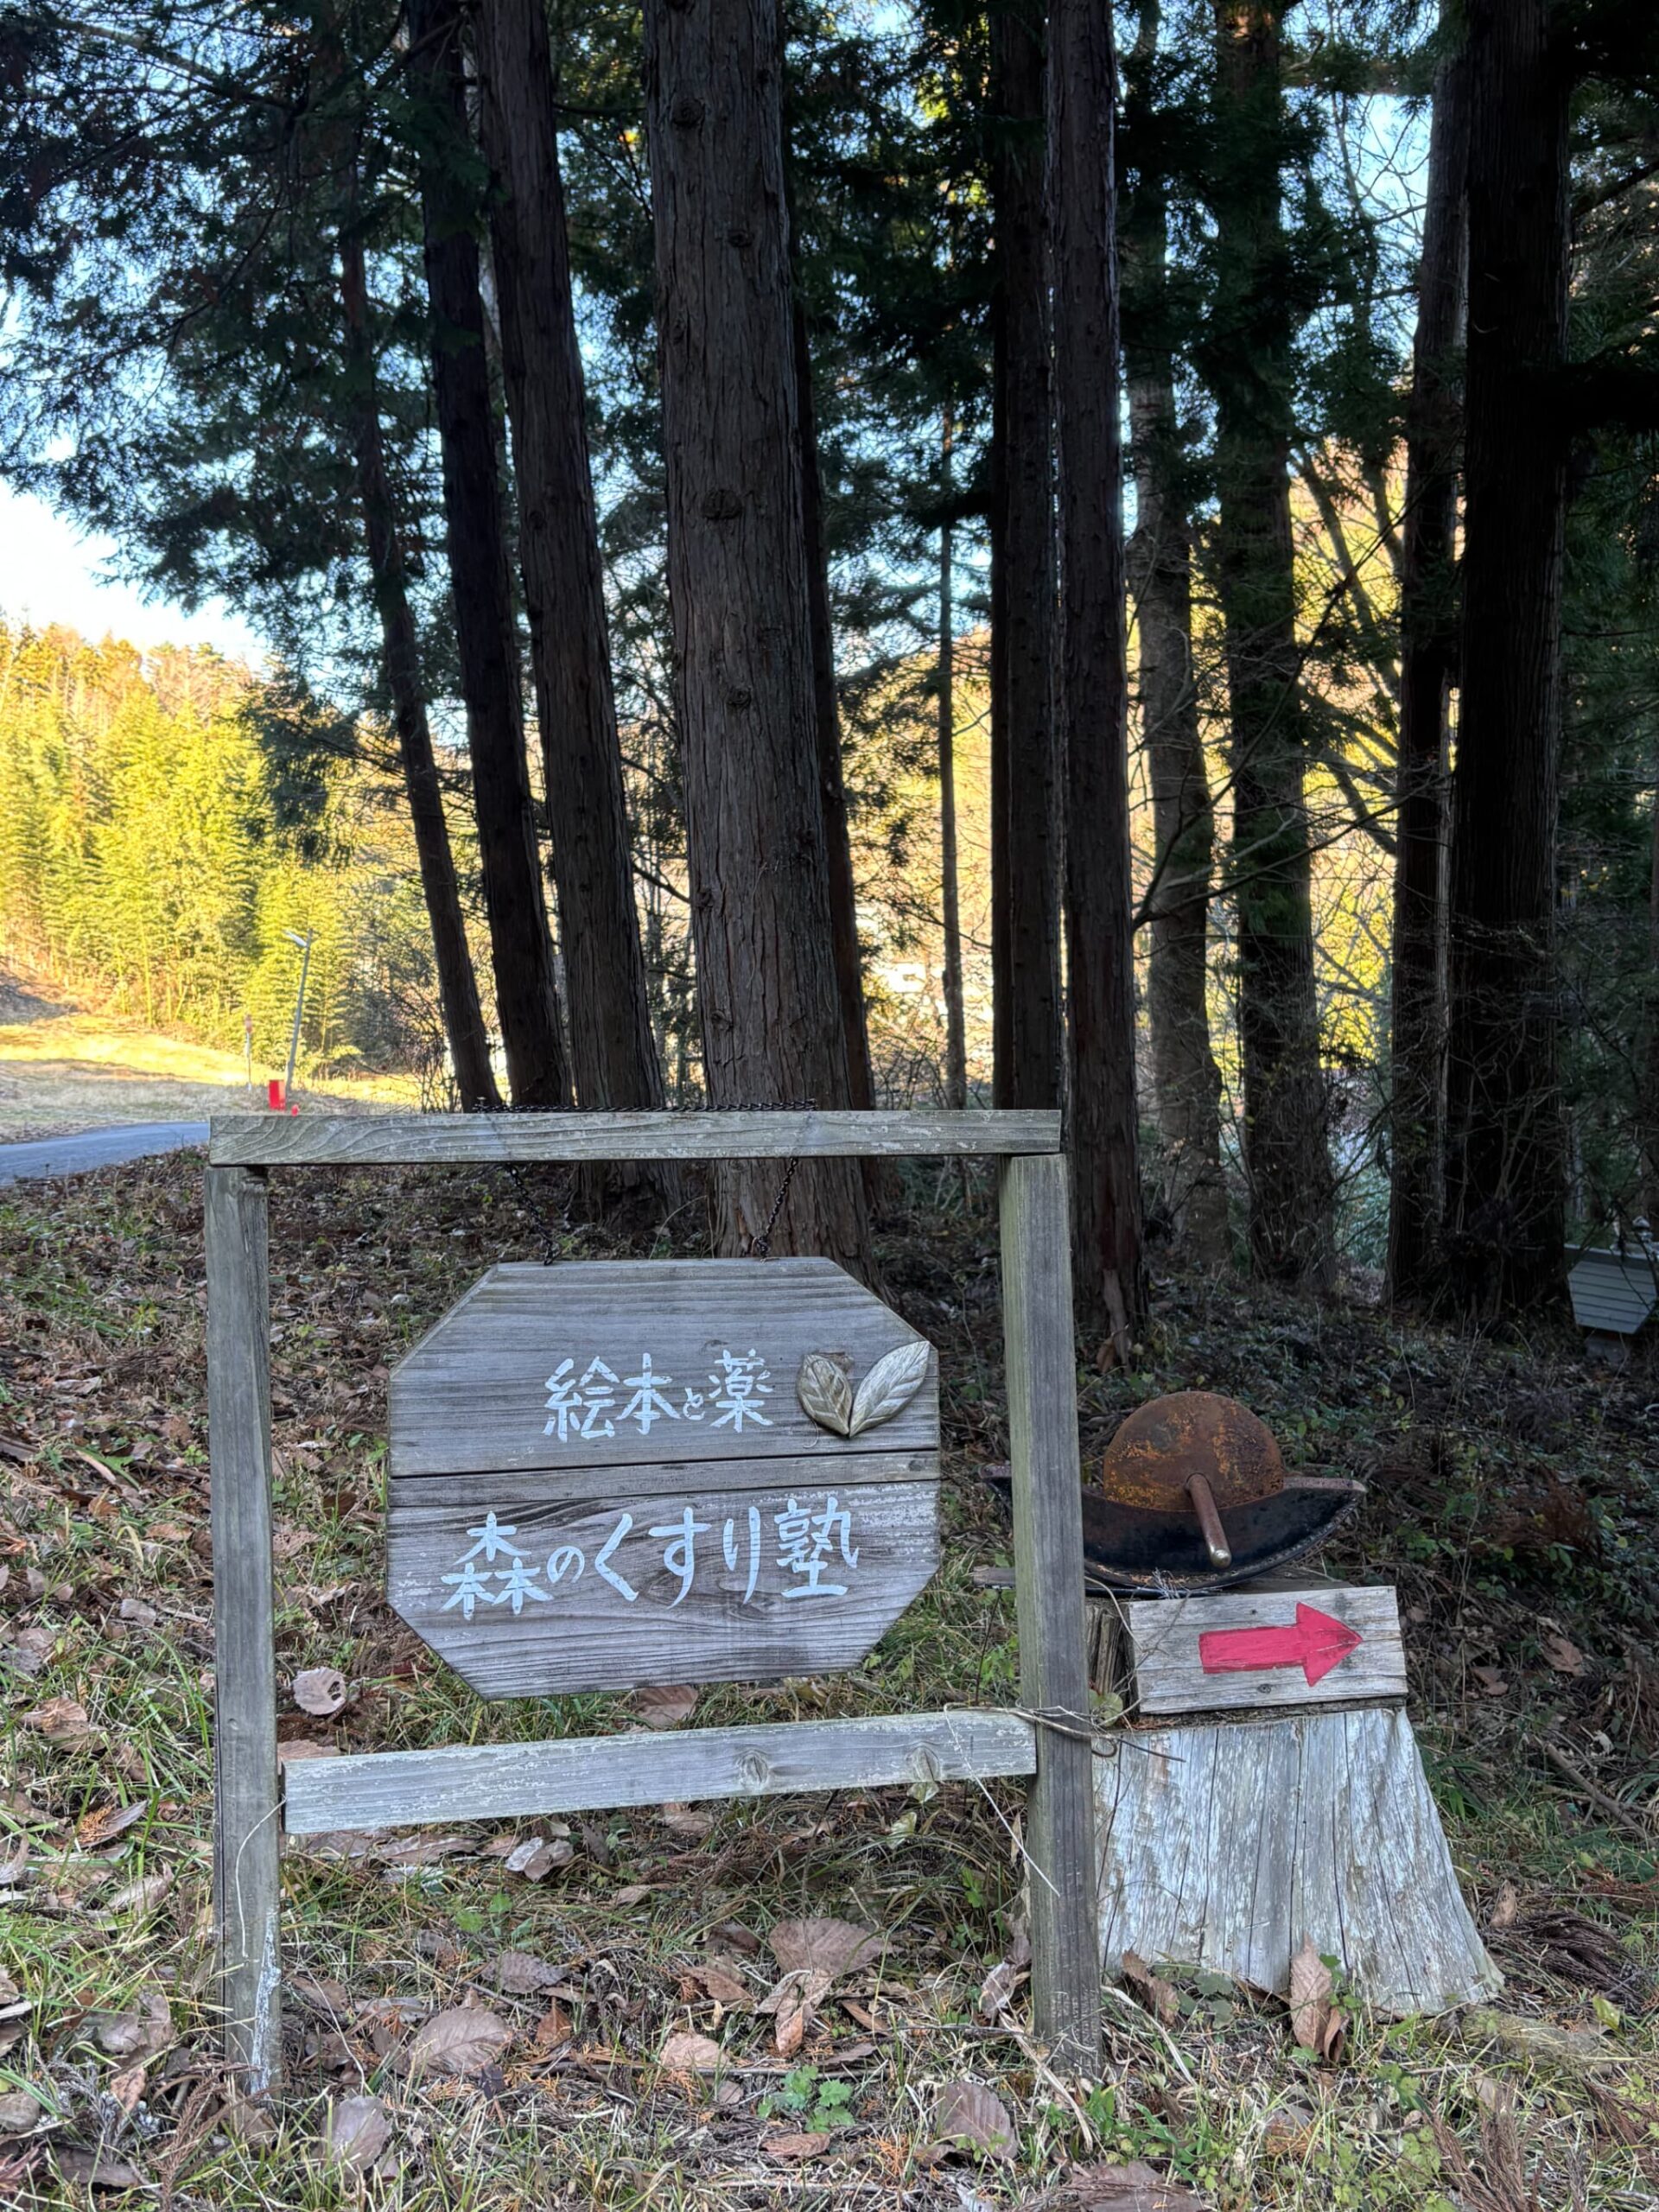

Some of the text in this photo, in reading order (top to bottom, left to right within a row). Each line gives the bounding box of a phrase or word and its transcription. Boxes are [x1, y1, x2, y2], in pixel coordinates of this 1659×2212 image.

[542, 1348, 774, 1442] 絵本と薬
[439, 1497, 861, 1619] 森のくすり塾
